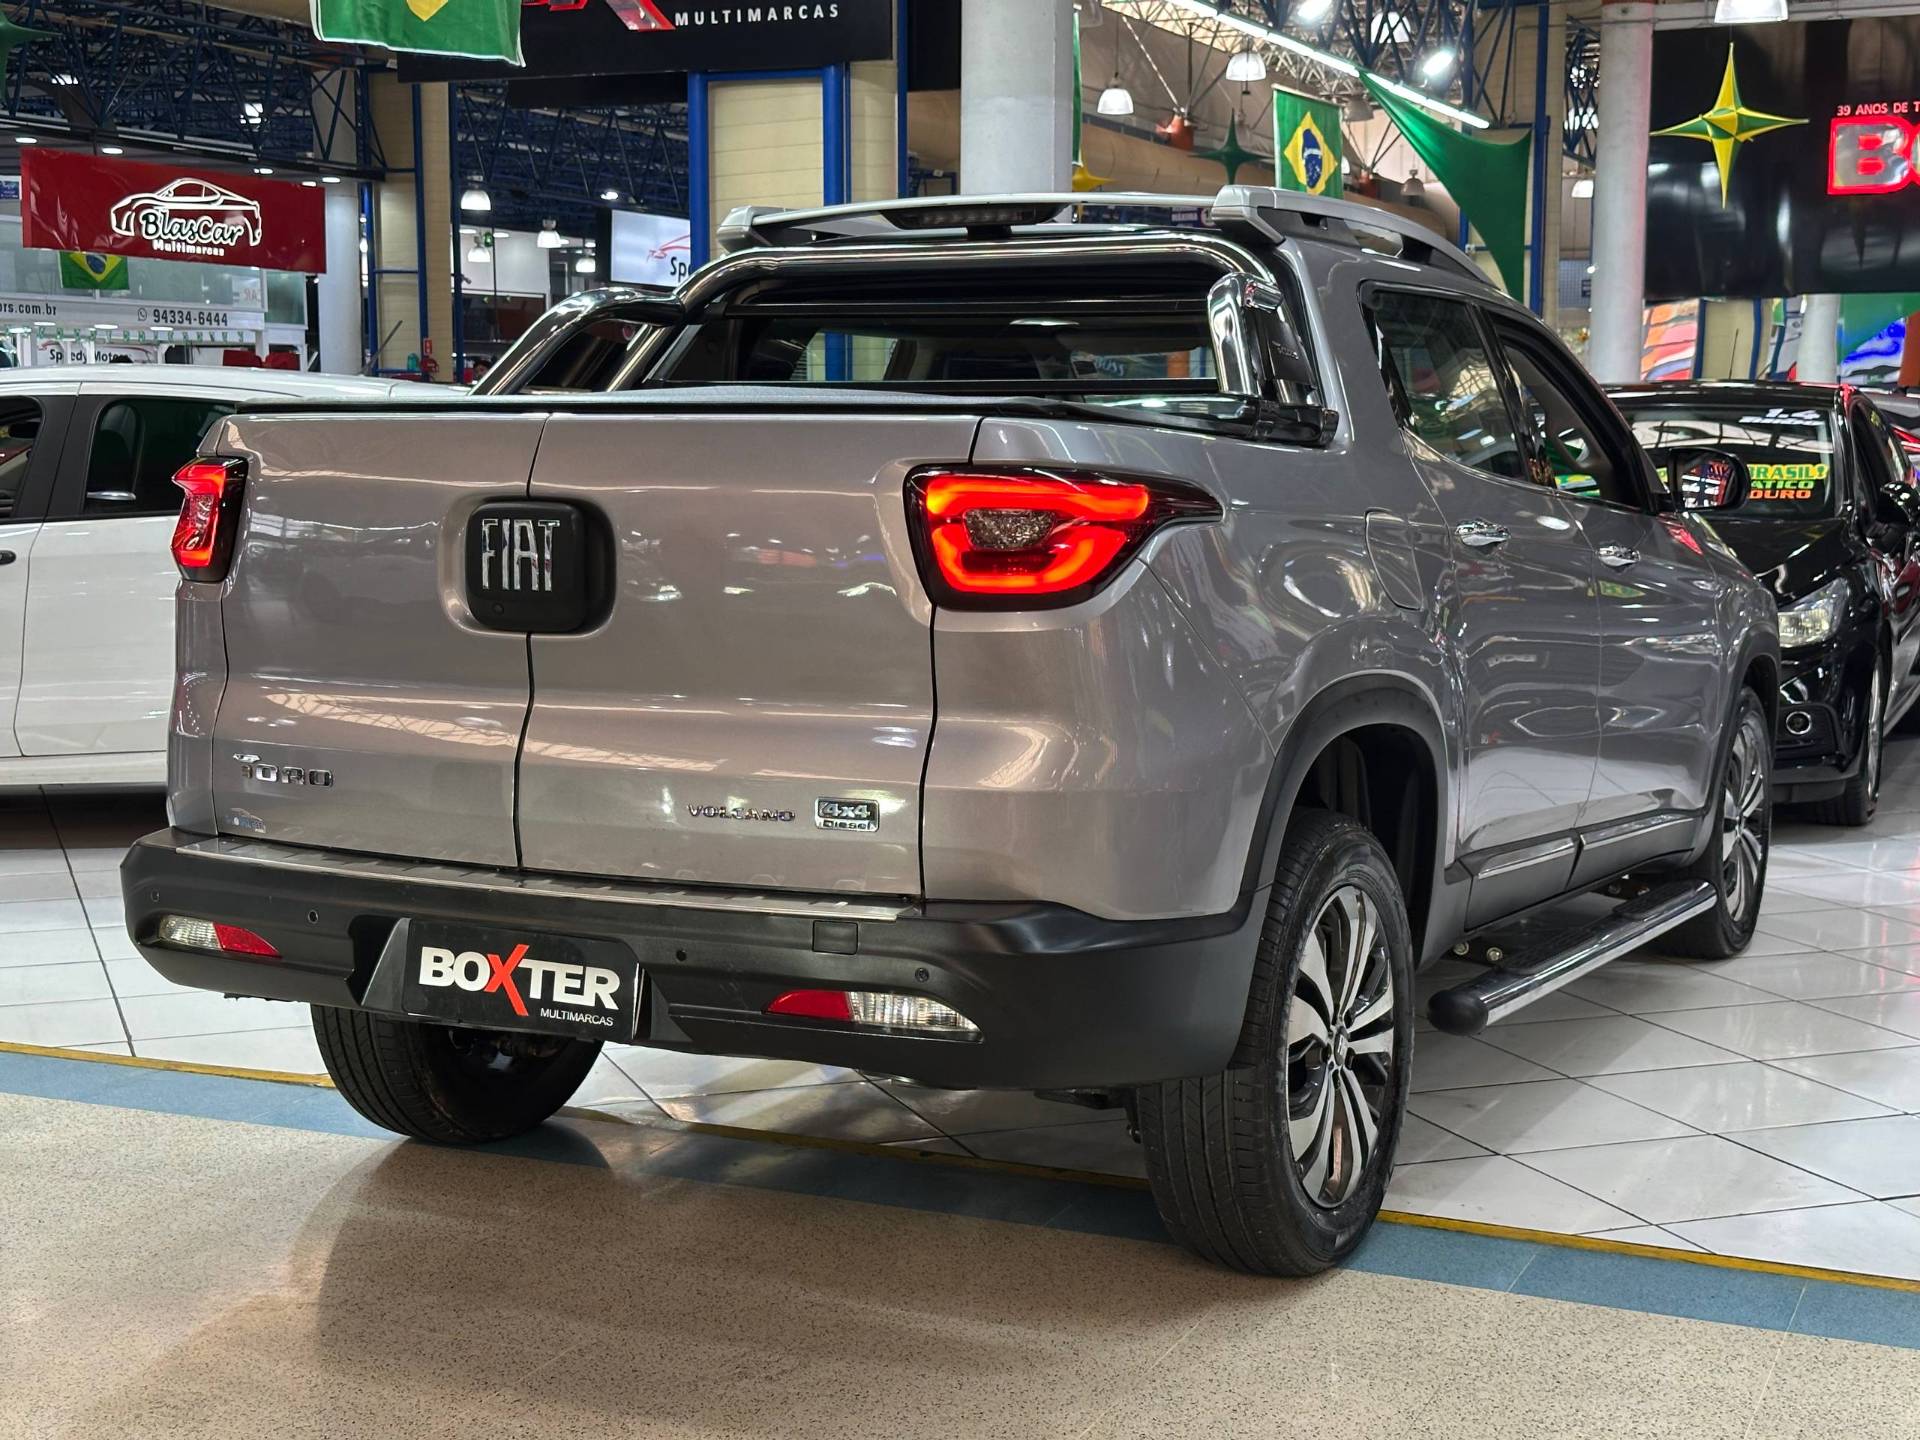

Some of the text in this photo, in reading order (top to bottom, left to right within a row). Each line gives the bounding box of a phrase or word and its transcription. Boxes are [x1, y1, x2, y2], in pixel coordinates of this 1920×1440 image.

[675, 4, 839, 26] MULTIMARCAS
[1837, 105, 1851, 116] 39
[1855, 103, 1888, 115] ANOS
[1893, 102, 1908, 114] DE
[140, 208, 245, 246] BlasCar
[153, 239, 224, 256] Multimarcas
[670, 256, 692, 282] Sp
[153, 309, 228, 326] 94334-6444
[482, 519, 560, 592] FIAT
[233, 754, 334, 787] TORO
[687, 805, 796, 822] VOLCANO
[820, 802, 871, 819] 4x4
[419, 944, 620, 1016] BOXTER
[540, 1007, 614, 1026] MULTIMARCAS
